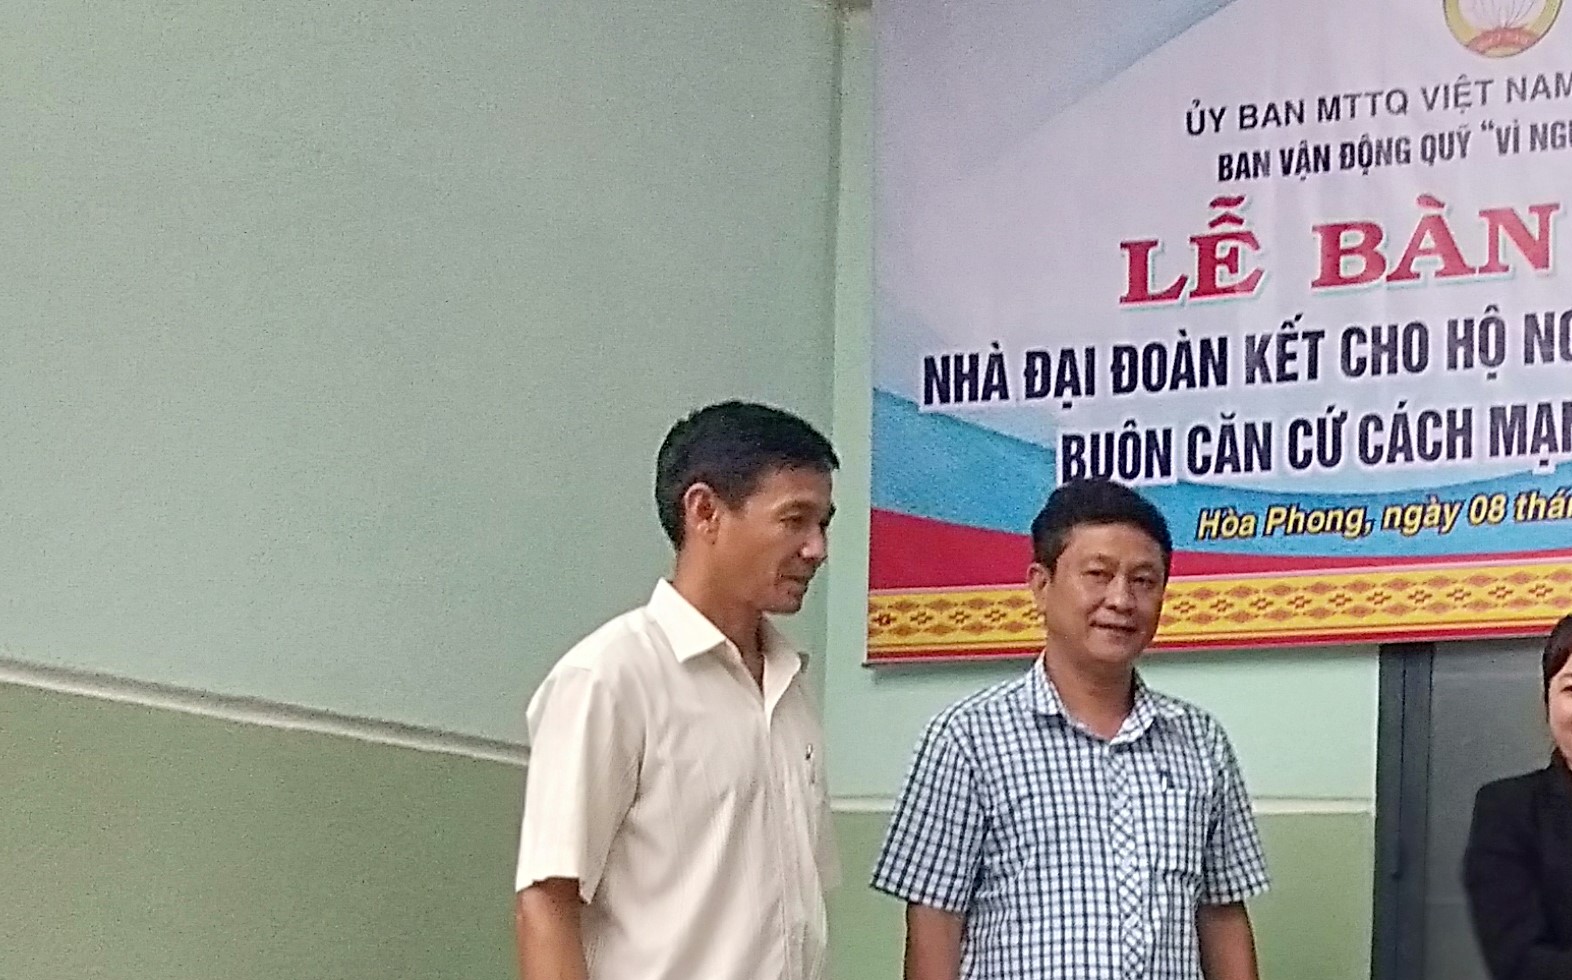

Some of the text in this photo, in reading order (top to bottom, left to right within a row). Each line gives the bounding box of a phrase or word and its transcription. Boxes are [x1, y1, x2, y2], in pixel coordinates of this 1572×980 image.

[1186, 99, 1226, 136] ỦY
[1239, 99, 1305, 130] BAN
[1318, 89, 1408, 122] MTTQ
[1421, 74, 1494, 113] VIỆT
[1218, 150, 1271, 181] BAN
[1280, 140, 1331, 181] VẬN
[1340, 134, 1411, 176] ĐỘNG
[1420, 125, 1471, 166] QUỸ
[1120, 195, 1265, 304] LỄ
[1311, 193, 1560, 289] BÀN
[923, 341, 1009, 406] NHÀ
[1024, 346, 1095, 409] ĐẠI
[1111, 329, 1228, 396] ĐOÀN
[1245, 313, 1325, 385] KẾT
[1341, 321, 1429, 378] CHO
[1446, 304, 1506, 380] HỘ
[1062, 420, 1172, 483] BUÔN
[1187, 412, 1272, 476] CĂN
[1288, 404, 1348, 471] CỨ
[1358, 399, 1472, 468] CÁCH
[1196, 506, 1256, 541] Hòa
[1263, 503, 1376, 540] Phong,
[1381, 494, 1463, 537] ngày
[1467, 493, 1508, 526] 08
